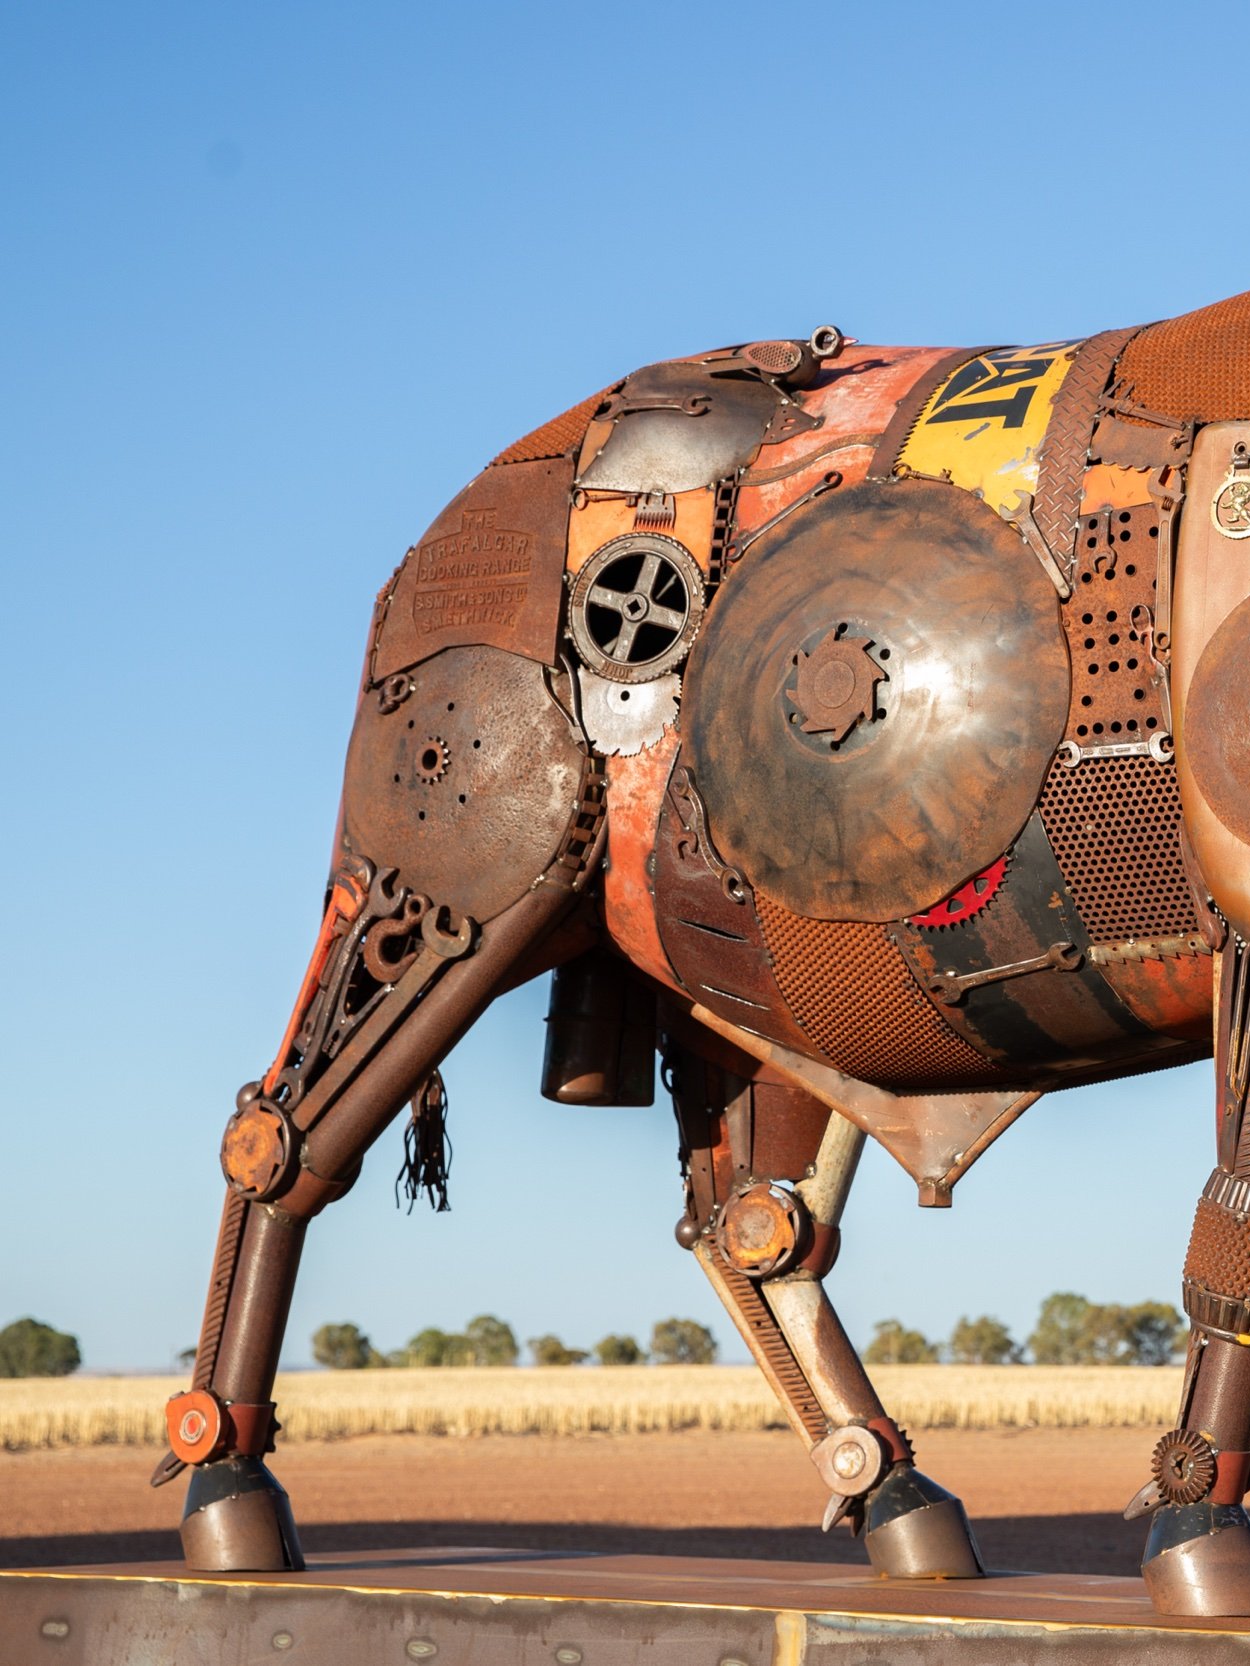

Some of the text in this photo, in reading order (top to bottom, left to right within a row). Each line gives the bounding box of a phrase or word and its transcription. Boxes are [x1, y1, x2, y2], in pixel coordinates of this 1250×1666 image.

[463, 512, 497, 530] THE
[426, 535, 529, 562] TRAFALGAR
[420, 557, 531, 581] COOKING RANGE
[574, 571, 593, 608] SHUT
[601, 660, 633, 679] JOHN
